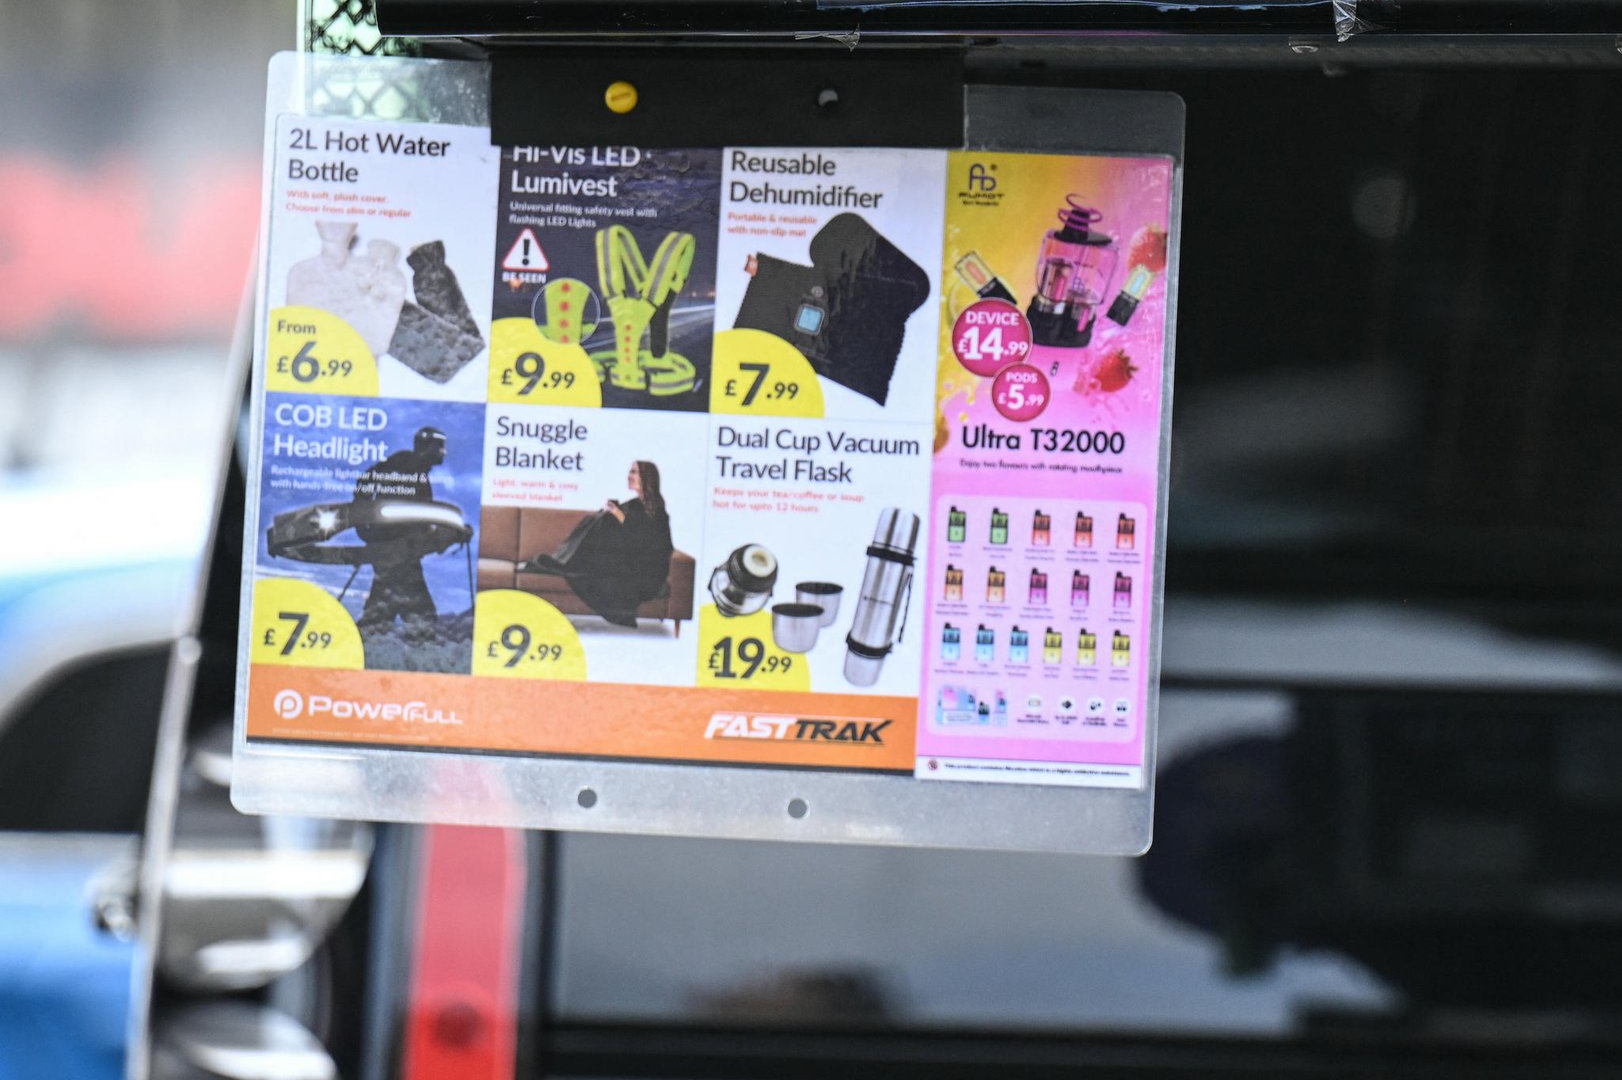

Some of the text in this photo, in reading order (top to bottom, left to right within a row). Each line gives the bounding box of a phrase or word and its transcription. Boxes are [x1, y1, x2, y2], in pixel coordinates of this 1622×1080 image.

[289, 128, 451, 157] 2L Hot Water
[591, 146, 641, 168] LED
[732, 150, 836, 175] Reusable
[288, 160, 359, 184] Bottle
[511, 170, 618, 197] Lumivest
[730, 181, 883, 208] Dehumidifier
[276, 320, 316, 335] From
[965, 311, 1019, 326] DEVICE
[958, 326, 1029, 361] £14.99
[276, 341, 353, 383] £6.99
[501, 351, 575, 396] £9.99
[725, 361, 799, 407] £7.99
[1005, 372, 1038, 384] PODS
[998, 384, 1044, 410] £5.99
[275, 403, 388, 431] COB LED
[497, 416, 588, 444] Snuggle
[274, 433, 389, 465] Headlight
[718, 426, 920, 455] Dual Cup Vacuum
[962, 424, 1126, 454] Ultra T32000
[496, 446, 584, 471] Blanket
[716, 456, 852, 483] Travel Flask
[264, 612, 332, 656] £7.99
[487, 624, 562, 668] £9.99
[708, 637, 792, 680] £19.99
[704, 712, 894, 742] FASTTRAK
